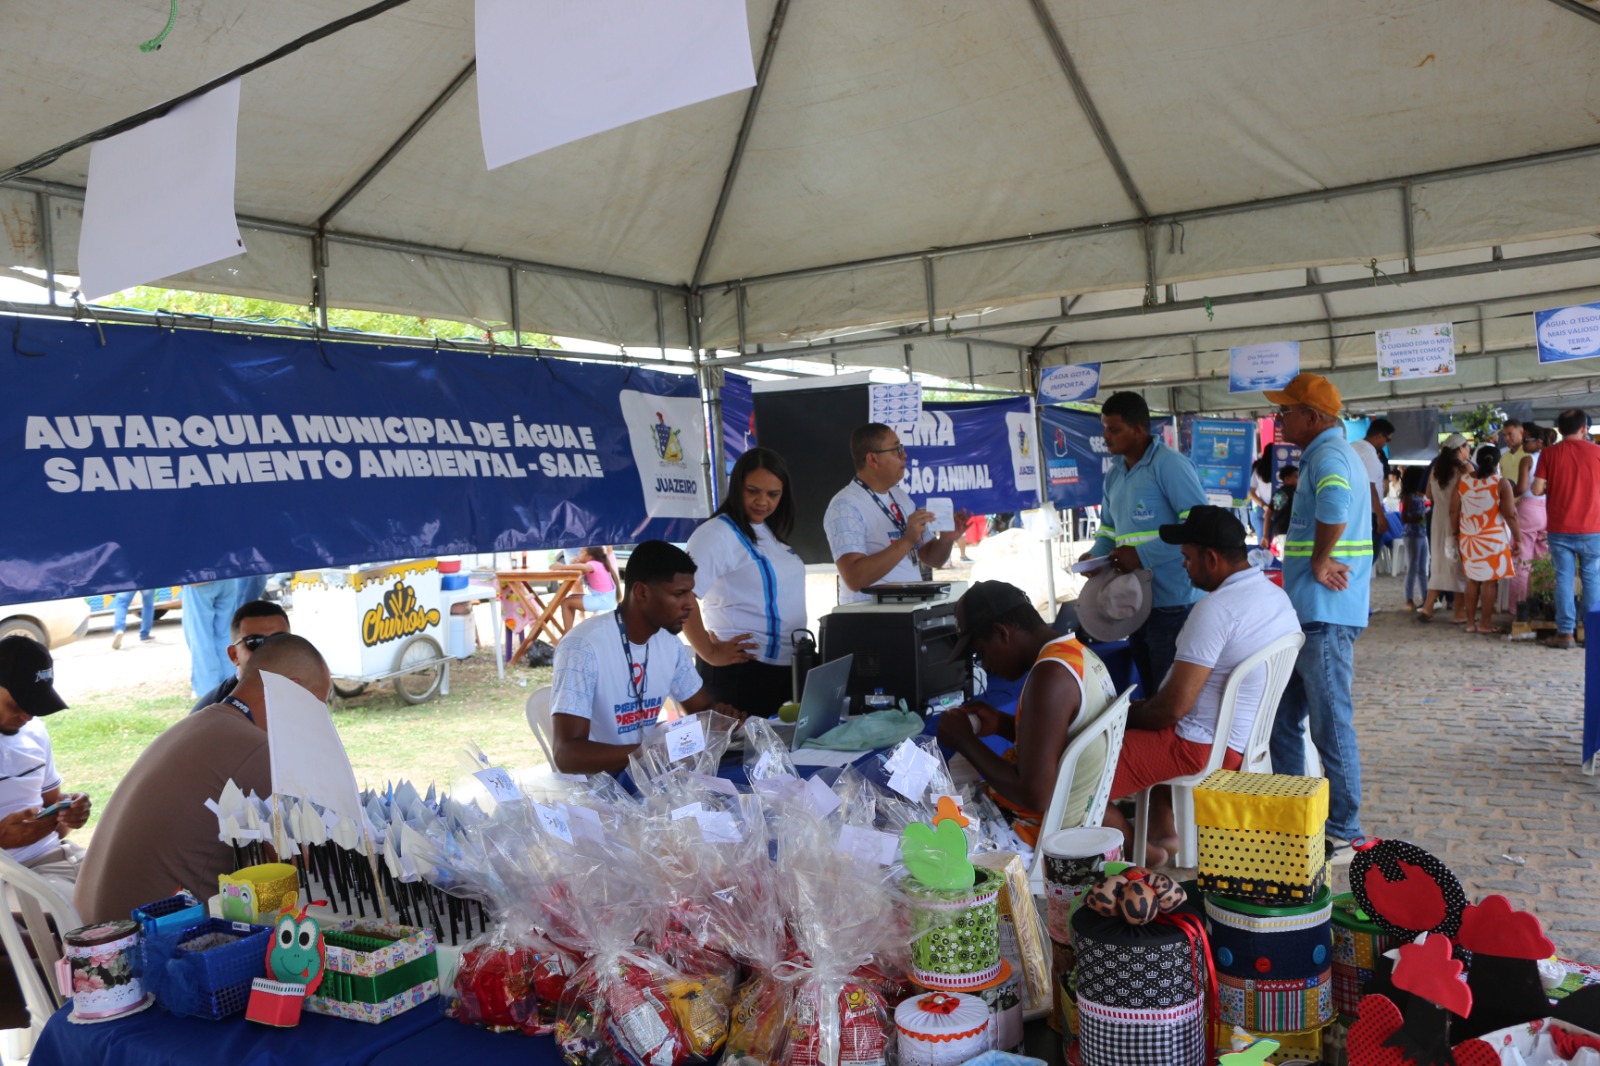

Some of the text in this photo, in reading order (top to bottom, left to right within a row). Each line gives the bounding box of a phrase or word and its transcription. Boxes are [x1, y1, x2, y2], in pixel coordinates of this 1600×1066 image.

[1547, 325, 1599, 337] MAIS VALIOSO
[1387, 341, 1415, 350] CUIDADO
[1389, 348, 1420, 357] AMBIENTE
[1392, 357, 1417, 365] DENTRO
[1049, 369, 1091, 381] CADA GOTA
[25, 415, 597, 450] AUTARQUIA MUNICIPAL DE ÁGUA E
[43, 450, 353, 493] SANEAMENTO
[359, 450, 527, 478] AMBIENTAL
[539, 453, 605, 478] SAAE
[937, 464, 993, 493] ANIMAL
[655, 477, 698, 494] JUAZEIRO
[363, 603, 430, 647] Churros
